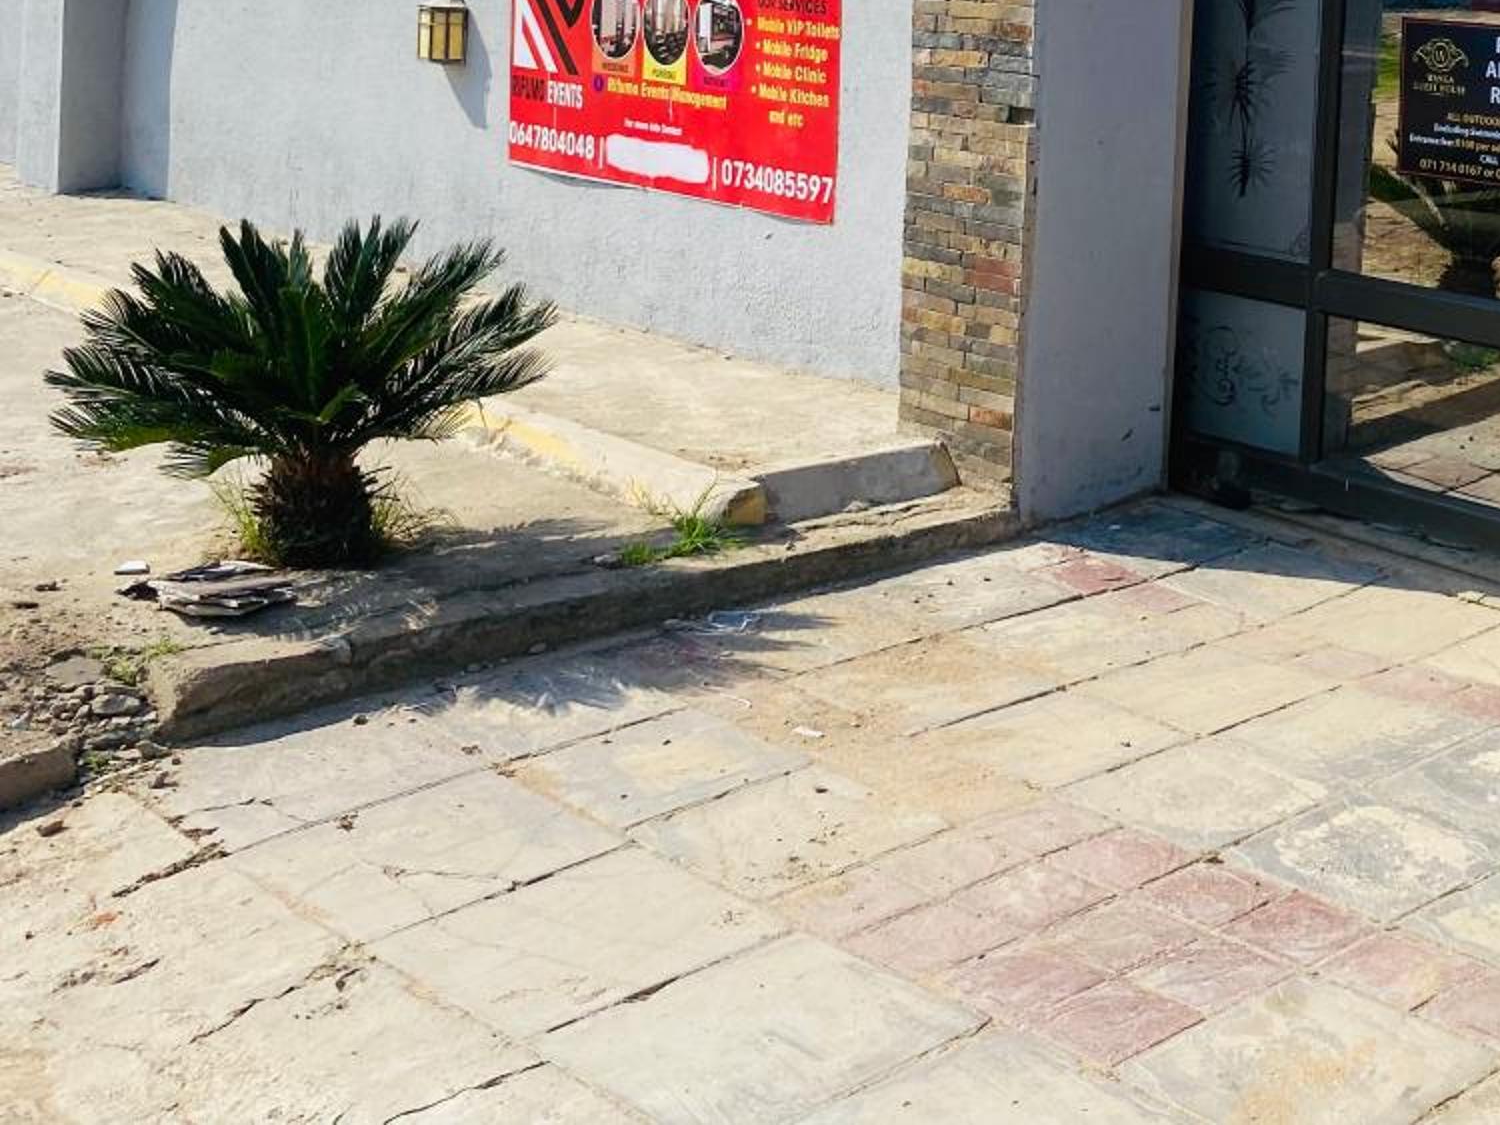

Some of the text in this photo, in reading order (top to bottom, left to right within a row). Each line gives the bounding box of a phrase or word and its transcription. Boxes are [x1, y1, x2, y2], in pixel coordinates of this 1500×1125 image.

[794, 65, 827, 84] Clinic
[546, 79, 584, 110] EVENTS
[509, 119, 595, 161] 0647804048
[721, 158, 833, 204] 0734085597
[1419, 158, 1437, 171] 071
[1483, 168, 1495, 177] or
